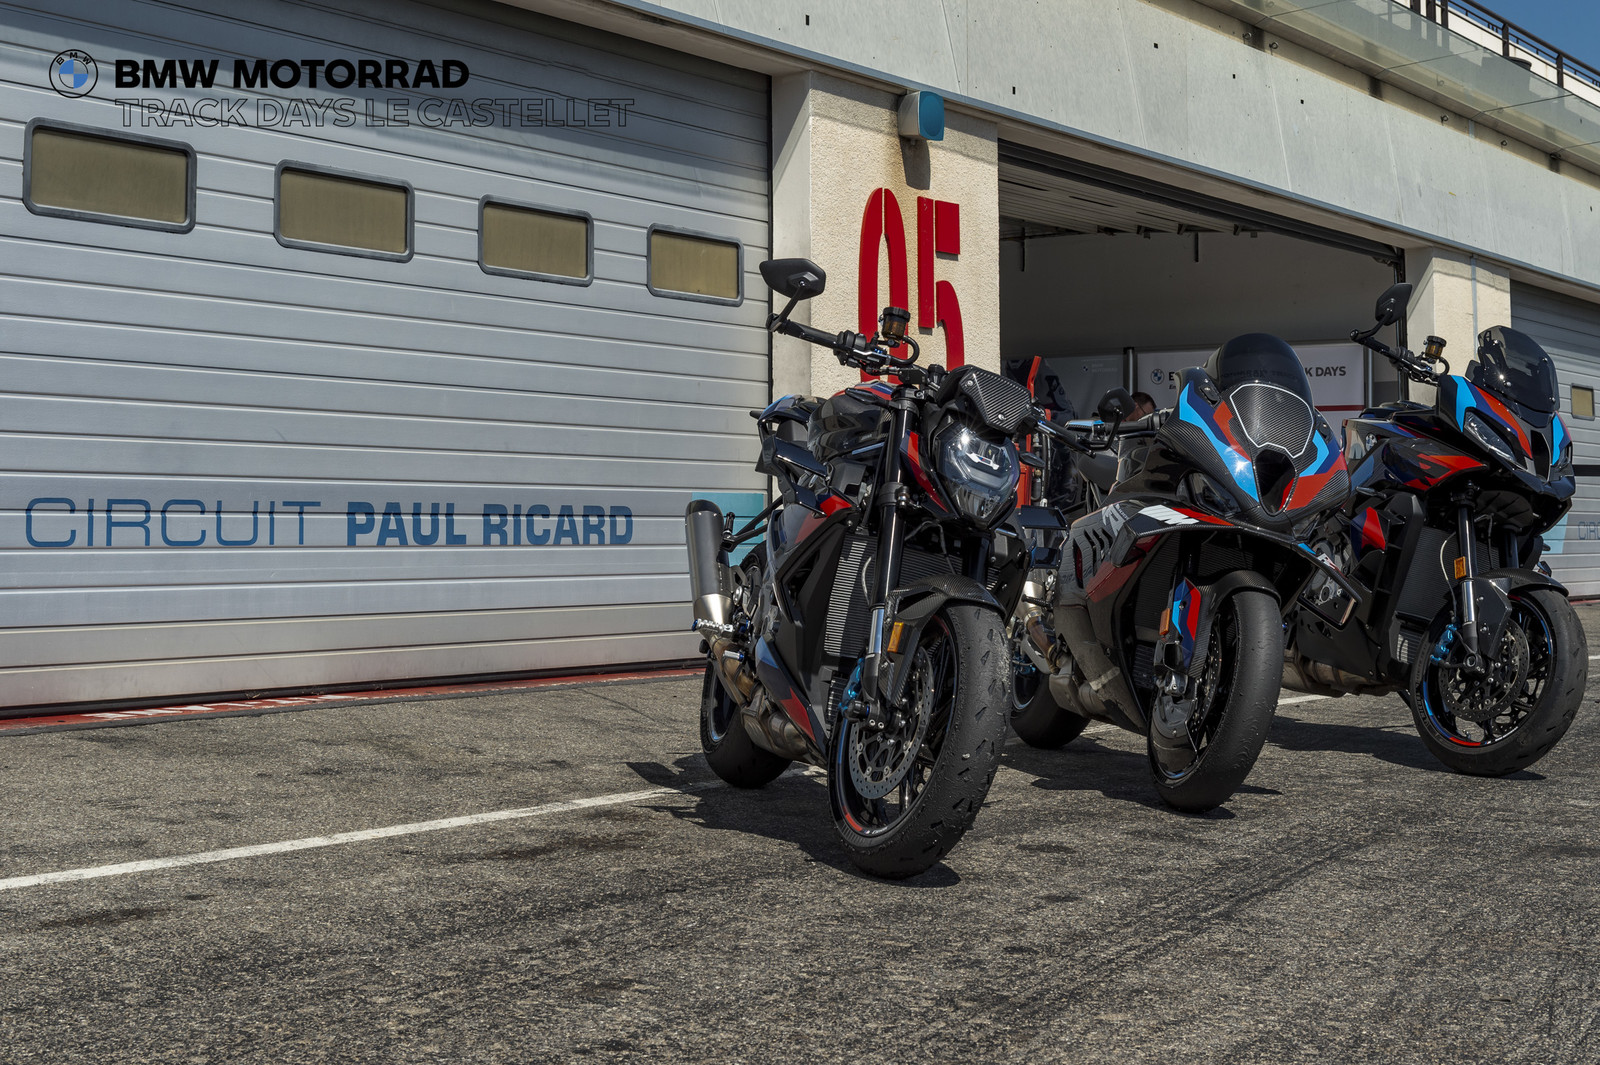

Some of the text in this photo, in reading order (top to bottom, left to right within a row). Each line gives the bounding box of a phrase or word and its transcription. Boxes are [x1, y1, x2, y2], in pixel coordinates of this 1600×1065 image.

[1315, 366, 1347, 377] DAYS
[26, 497, 633, 547] CIRCUIT PAUL RICARD
